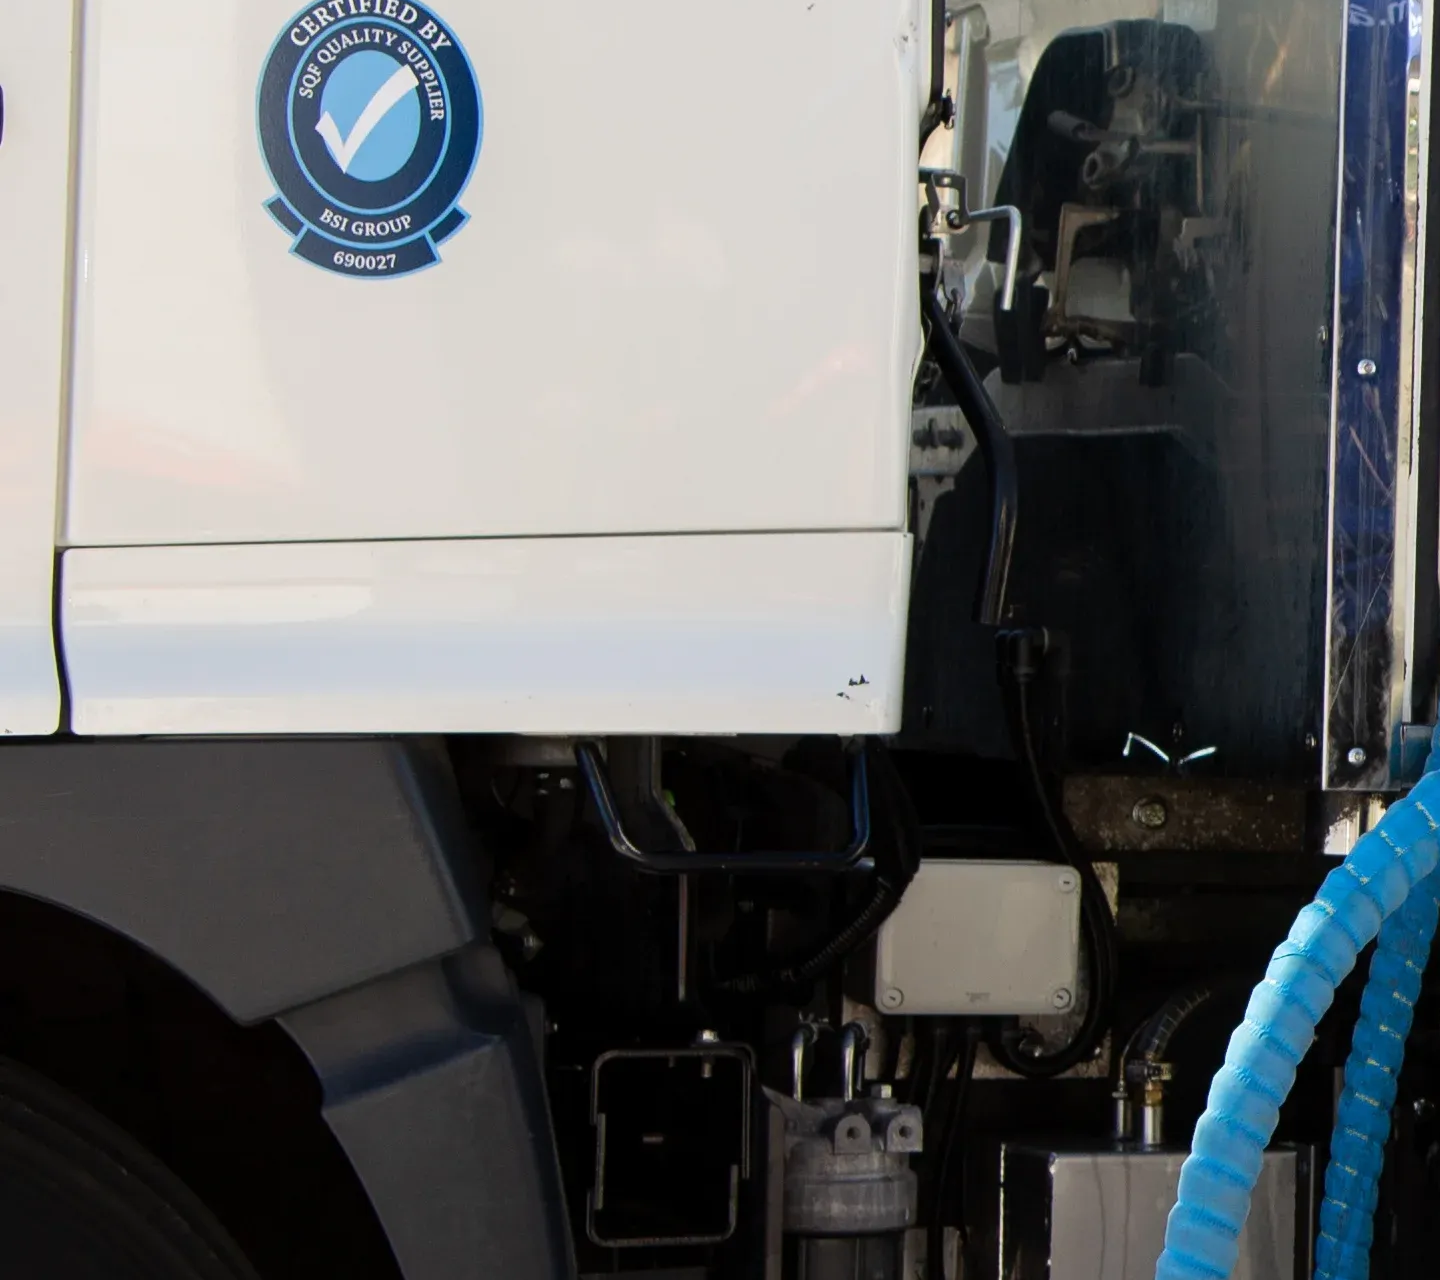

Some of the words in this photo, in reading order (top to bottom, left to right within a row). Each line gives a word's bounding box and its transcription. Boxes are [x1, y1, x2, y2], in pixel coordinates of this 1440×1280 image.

[418, 20, 451, 52] BY
[299, 62, 322, 99] SQF
[317, 28, 398, 65] QUALITY
[397, 41, 445, 121] SUPPLIER
[319, 208, 346, 231] BSI
[351, 214, 412, 237] GROUP
[333, 250, 397, 271] 690027
